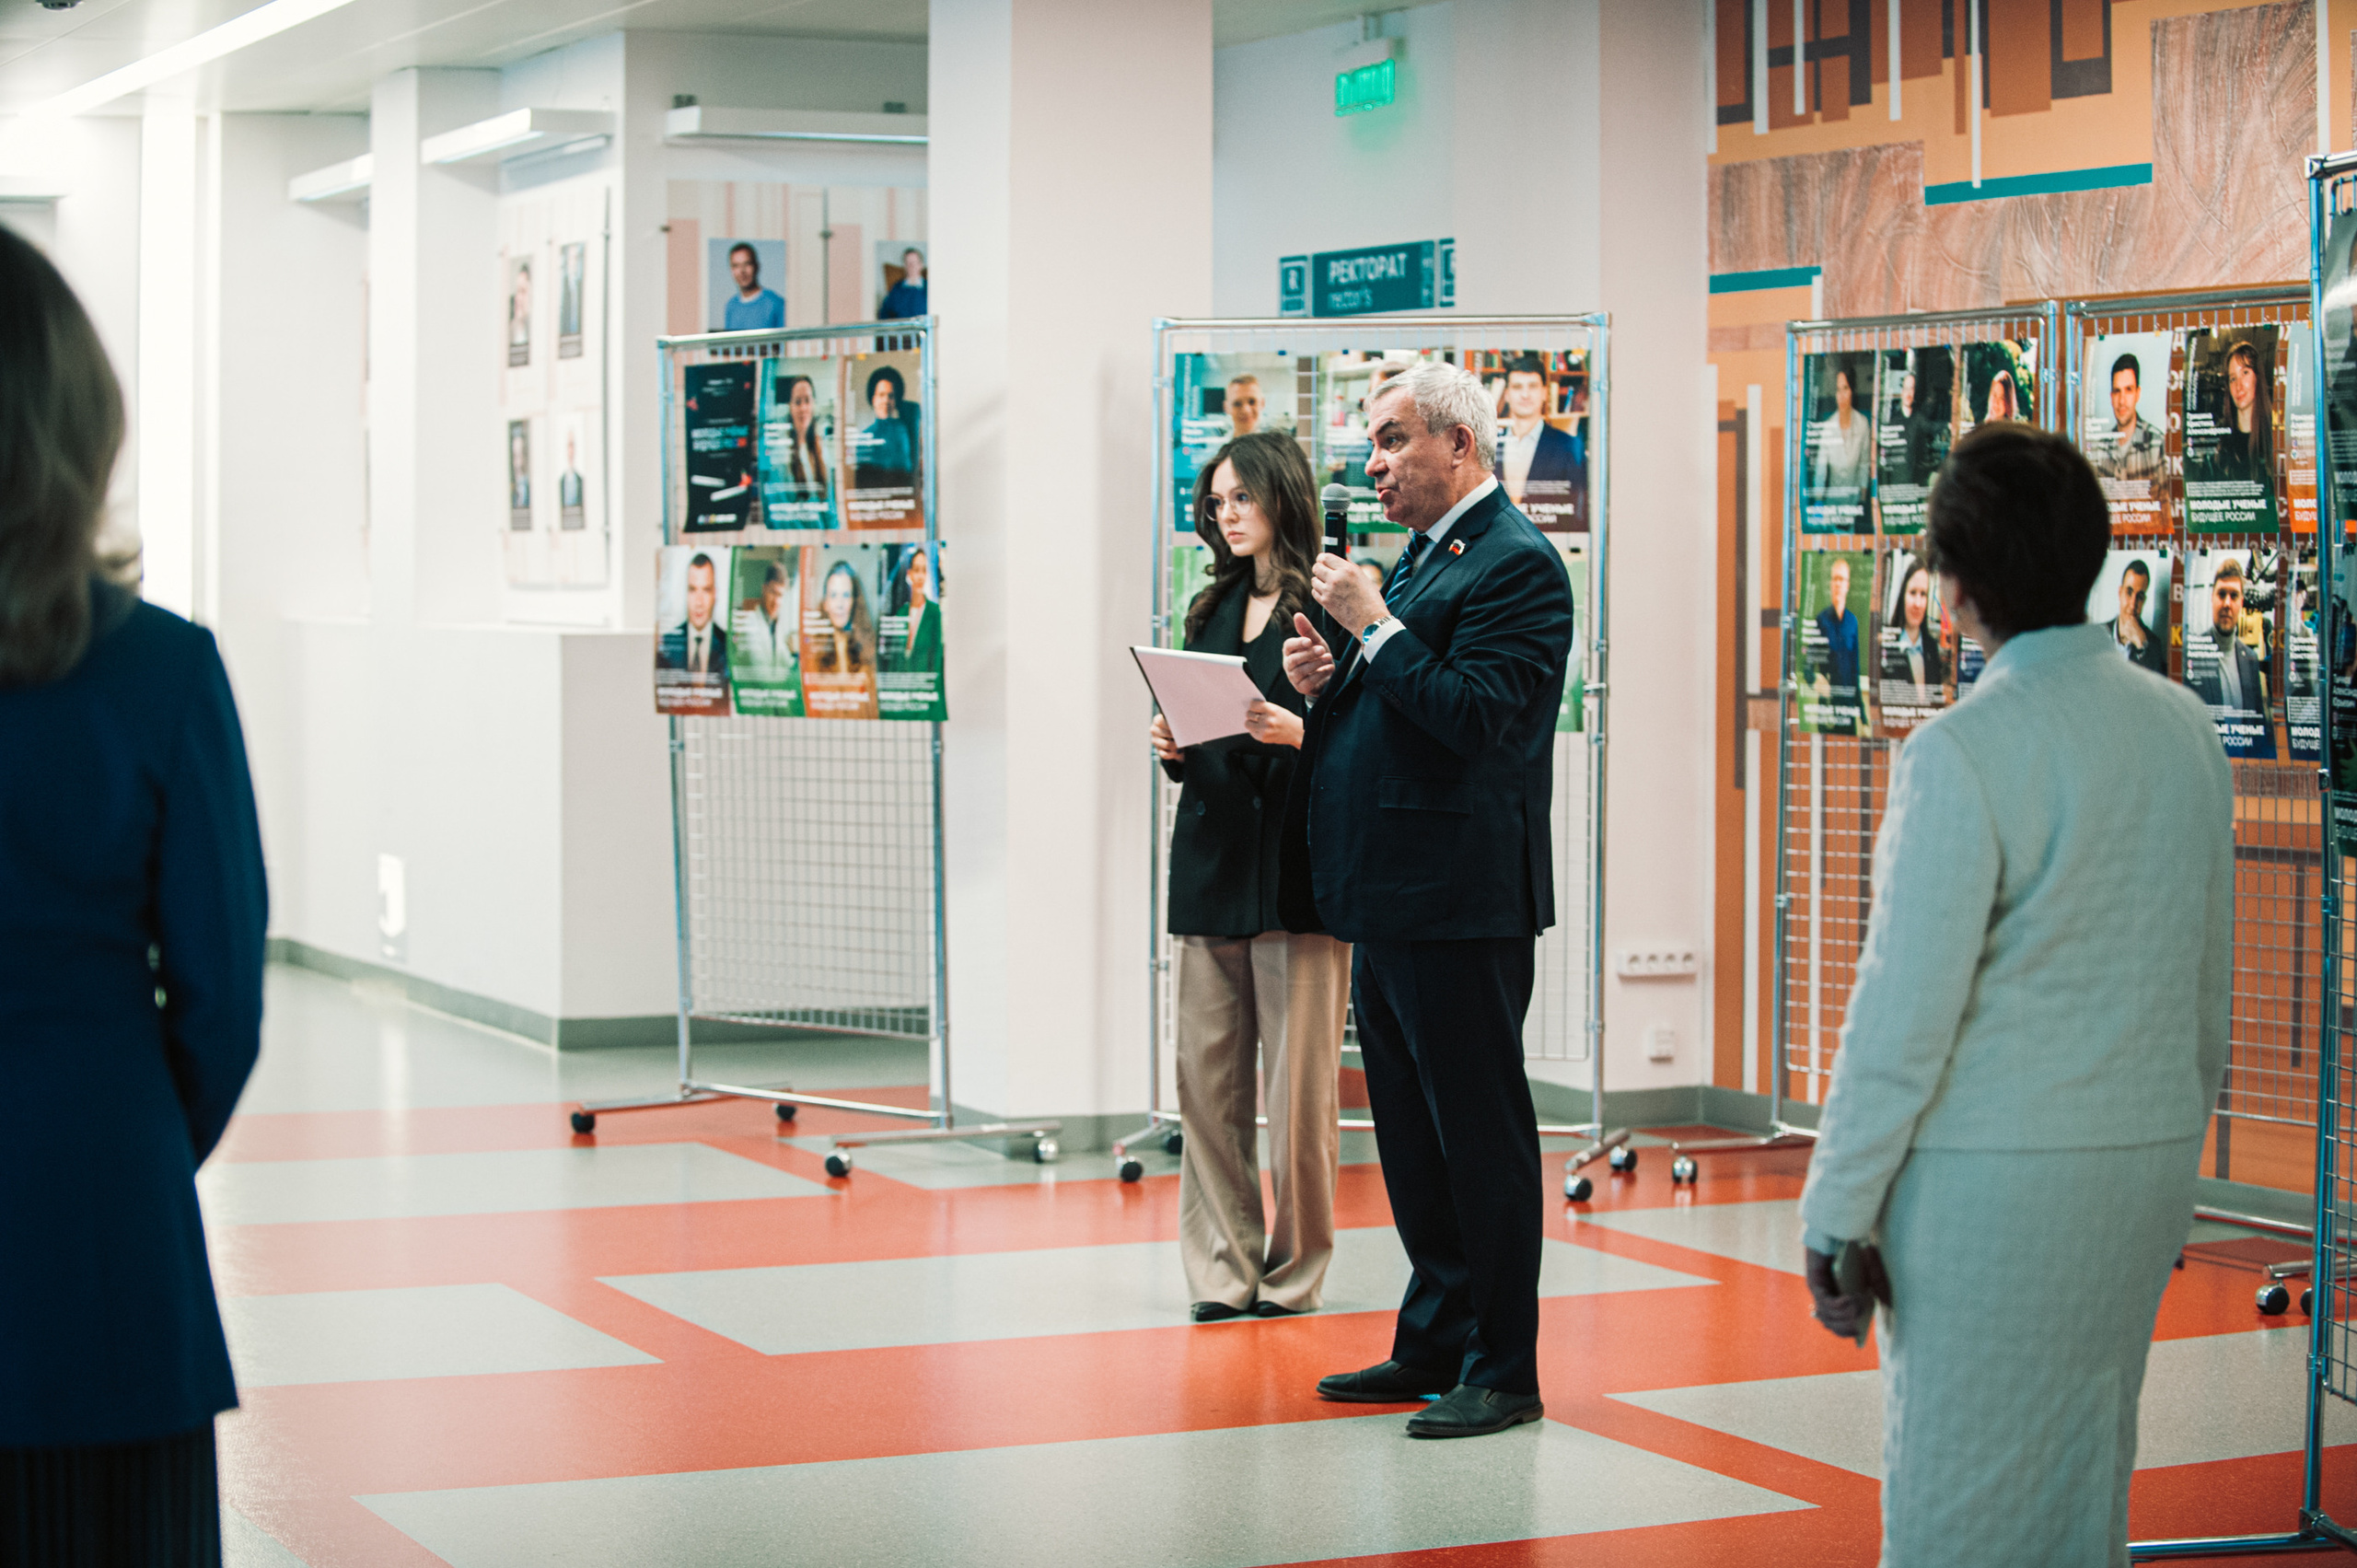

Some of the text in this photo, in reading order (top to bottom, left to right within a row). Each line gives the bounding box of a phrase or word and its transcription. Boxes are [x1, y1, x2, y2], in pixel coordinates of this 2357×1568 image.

[1328, 252, 1408, 285] РЕКТОРАТ
[2189, 498, 2268, 511] МОЛОДЫЕ УЧЕНЫЕ
[2191, 511, 2257, 524] БУДУЩЕЕ РОССИИ
[2230, 725, 2265, 736] УЧЕНЫЕ
[2291, 726, 2320, 738] МОЛОД
[2223, 736, 2254, 747] РОССИИ
[2292, 738, 2320, 750] БУДУЩЕ
